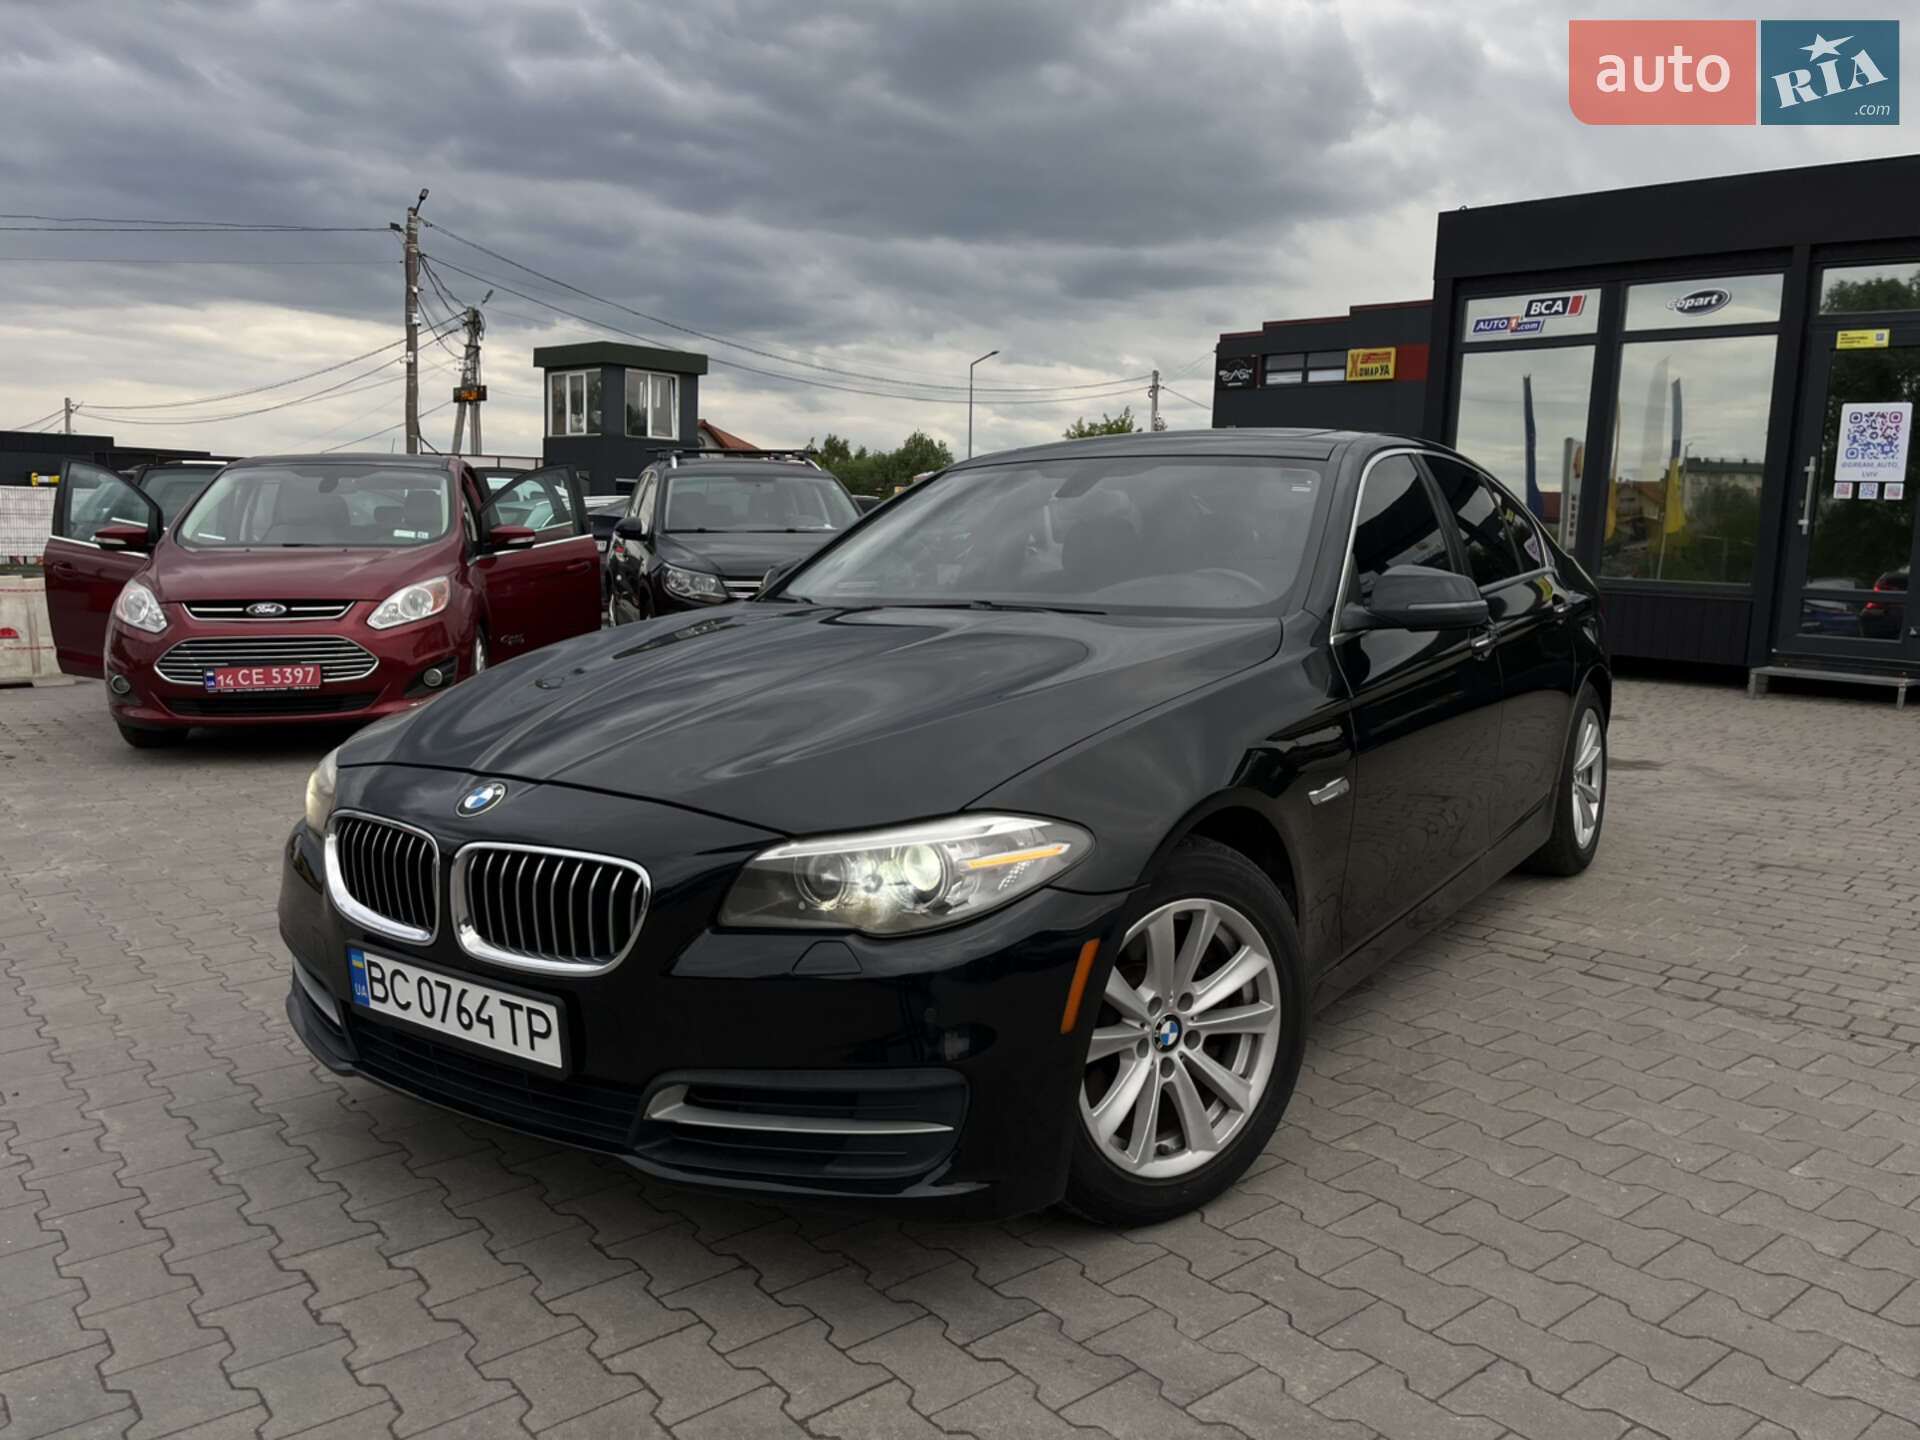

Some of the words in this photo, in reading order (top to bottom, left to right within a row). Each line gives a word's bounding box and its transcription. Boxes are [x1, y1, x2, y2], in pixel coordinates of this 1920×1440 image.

[1530, 300, 1564, 315] BCA
[217, 674, 234, 687] 14
[238, 669, 265, 685] CE
[271, 667, 315, 684] 5397
[355, 983, 368, 998] UA
